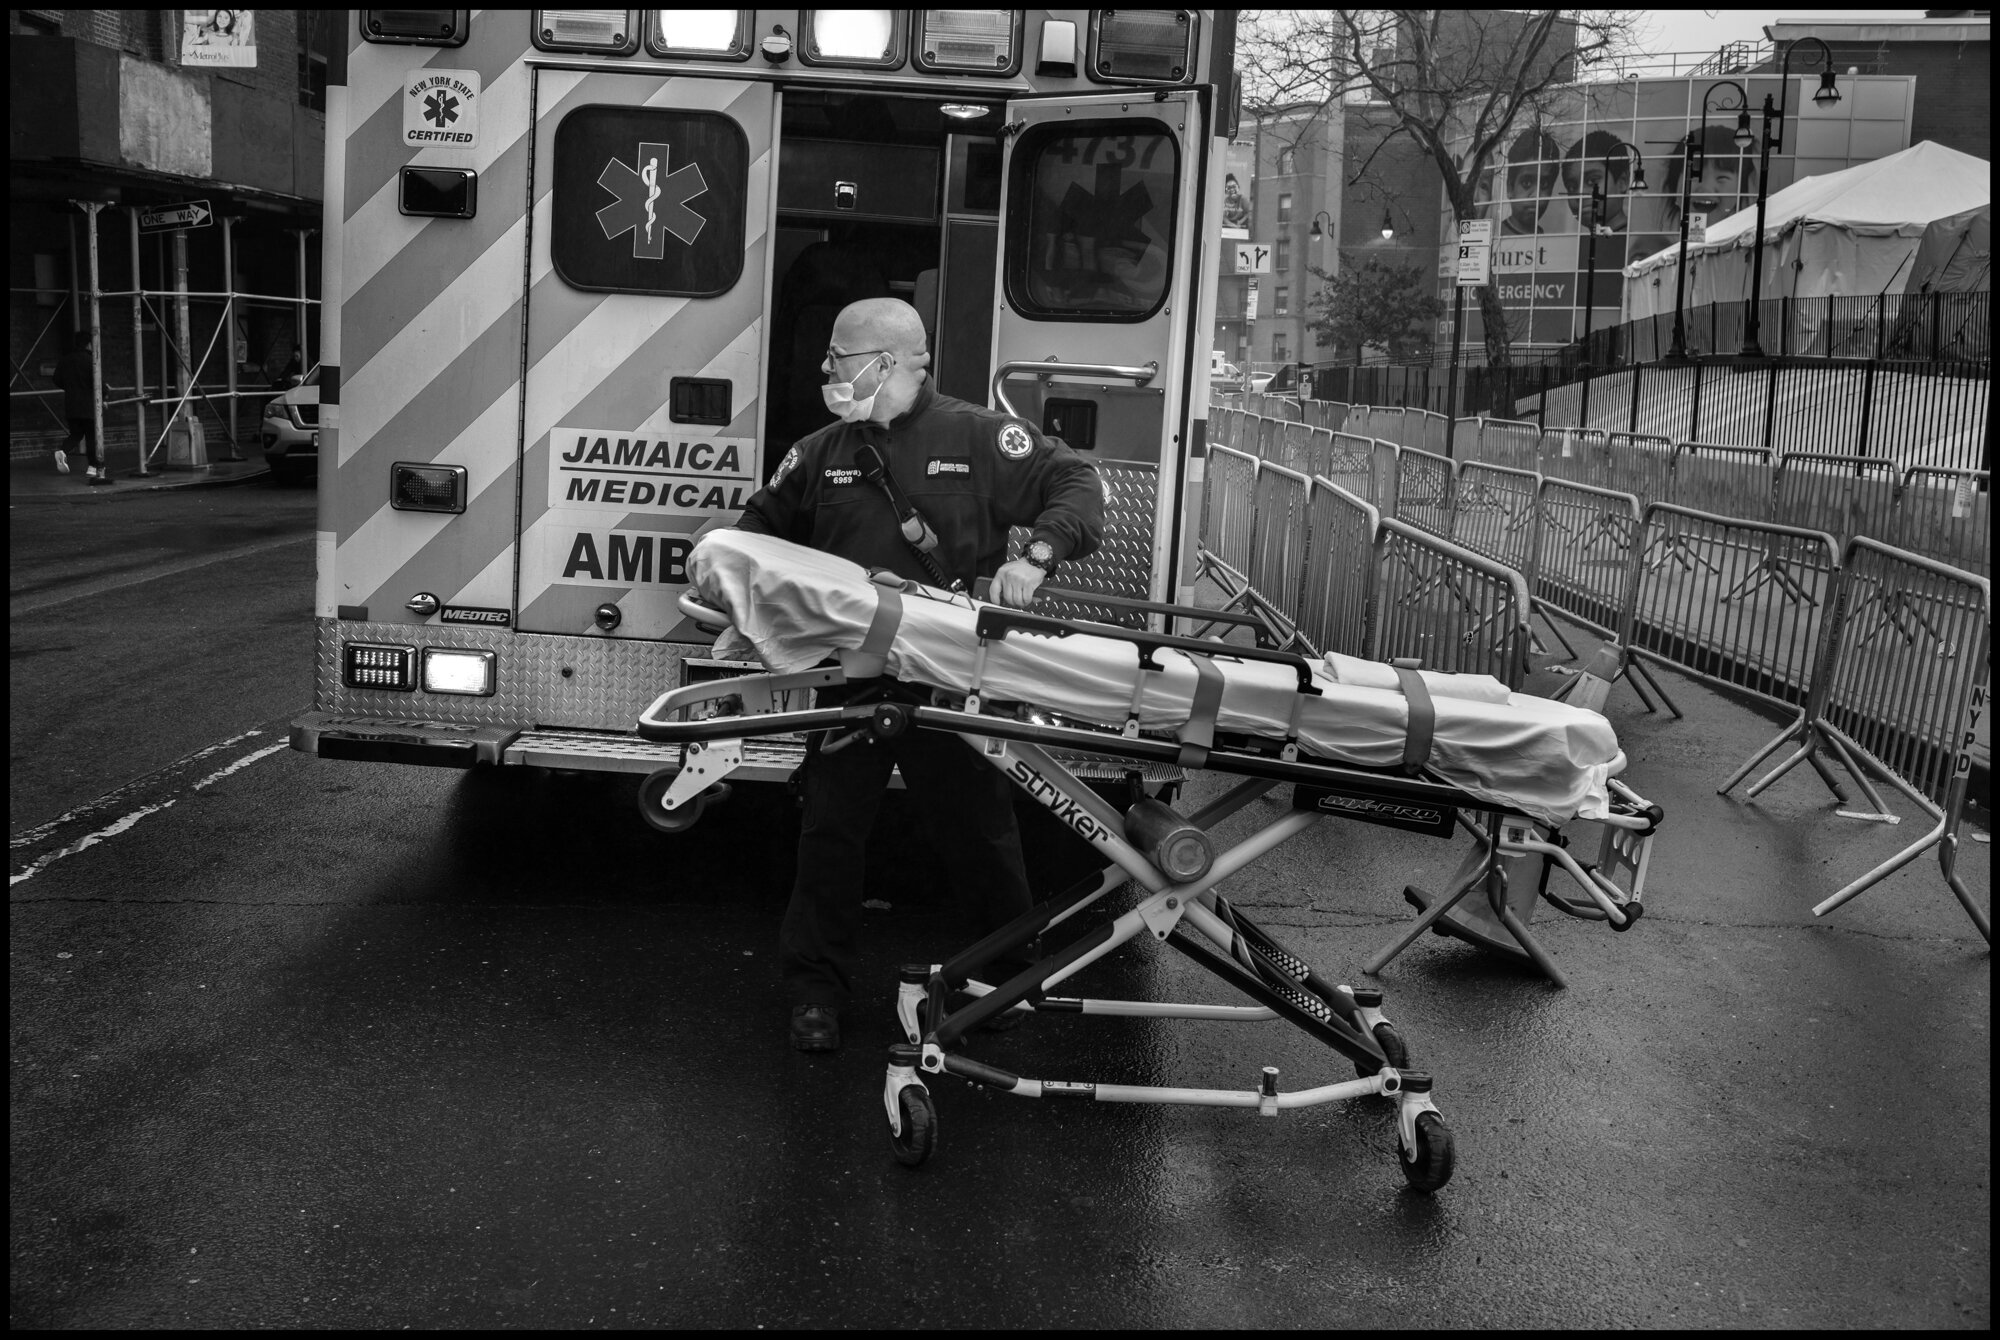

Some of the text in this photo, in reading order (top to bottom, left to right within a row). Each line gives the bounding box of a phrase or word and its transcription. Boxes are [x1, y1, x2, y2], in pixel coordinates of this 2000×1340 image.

[409, 76, 475, 100] NEW YORK STATE
[407, 130, 473, 143] CERTIFIED
[1045, 135, 1165, 169] 4737
[143, 208, 200, 226] ONE WAY
[1460, 246, 1468, 258] 2
[1498, 284, 1565, 300] ERGENCY
[562, 436, 741, 473] JAMAICA
[833, 476, 853, 484] 6959
[566, 477, 750, 511] MEDICAL
[443, 609, 508, 622] MEDTEC
[1957, 687, 1986, 773] NYPD
[1005, 760, 1109, 842] stryker
[1325, 795, 1438, 819] MX-PRO
